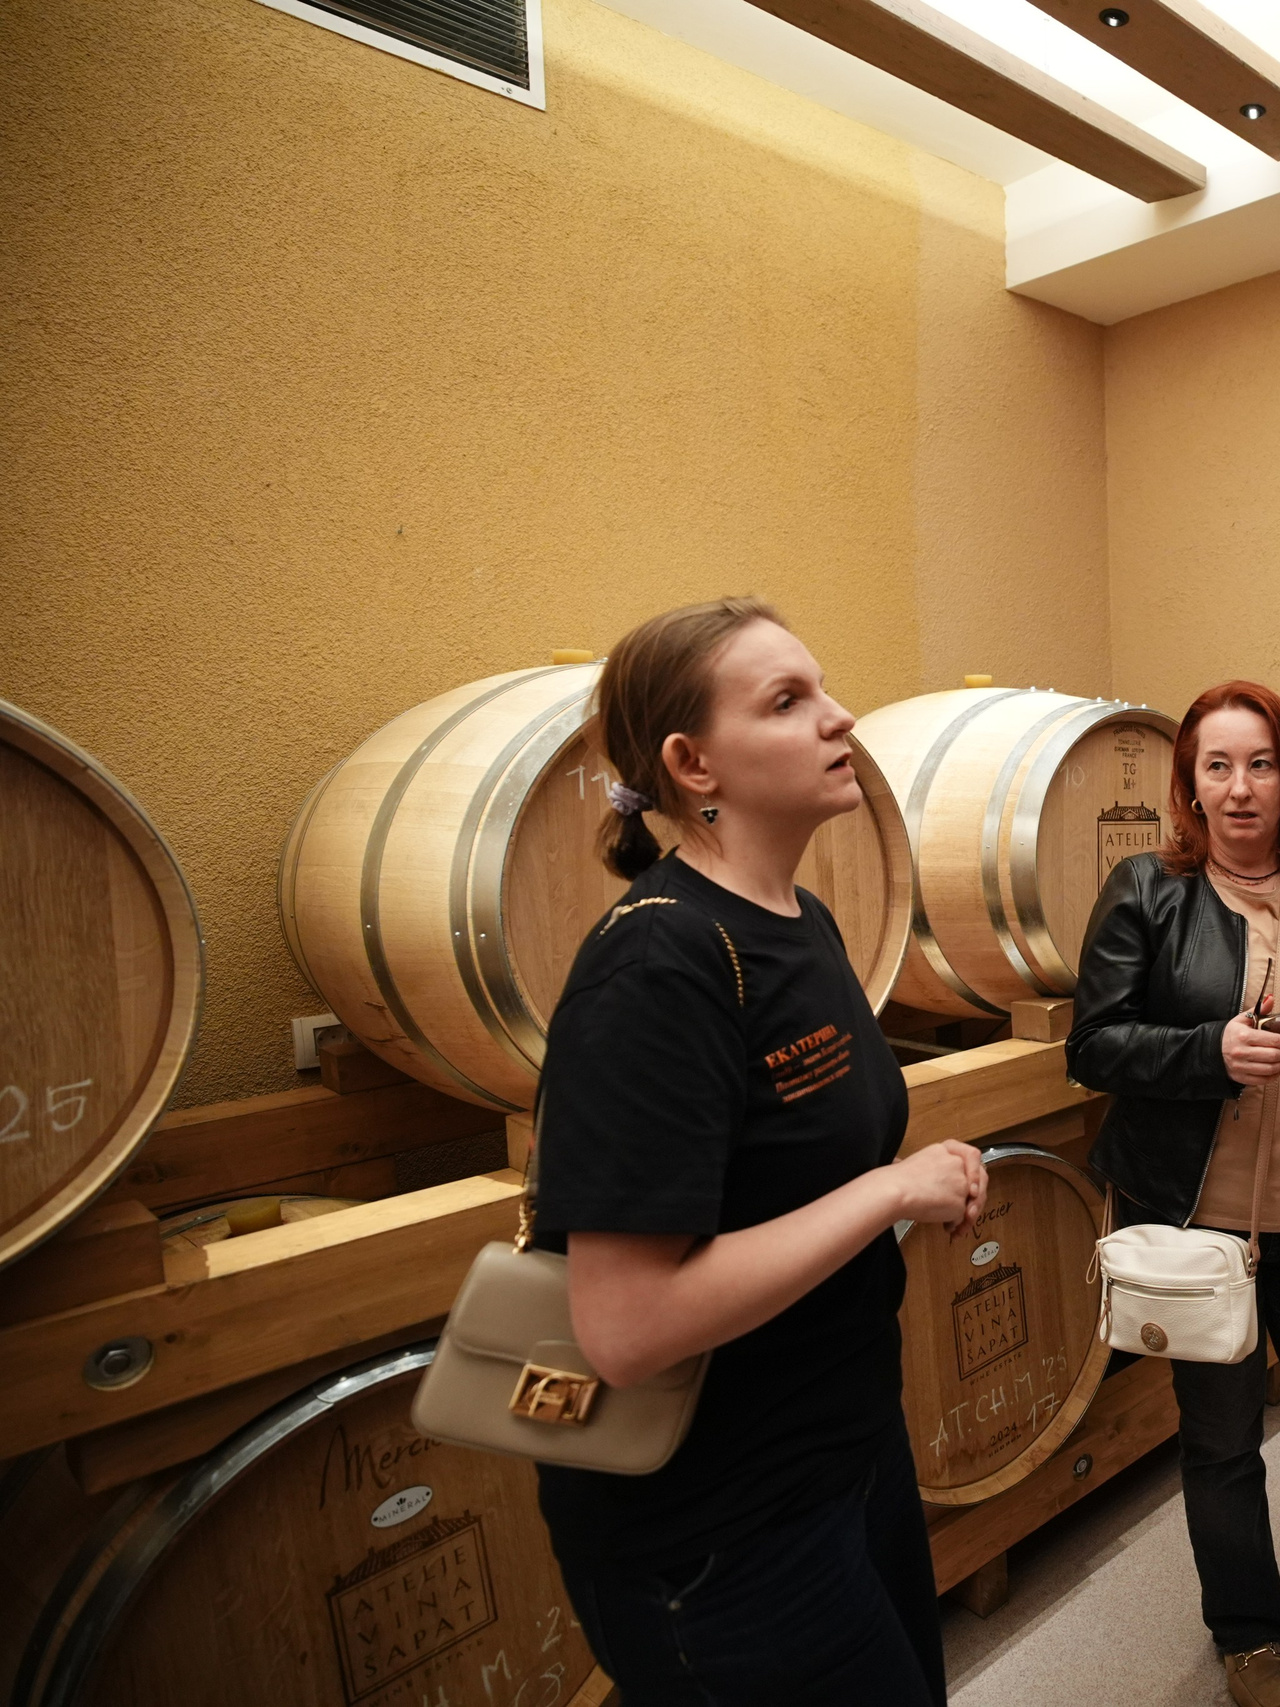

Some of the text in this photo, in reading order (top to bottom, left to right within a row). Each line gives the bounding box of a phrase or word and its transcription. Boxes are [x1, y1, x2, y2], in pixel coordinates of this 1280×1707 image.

[1060, 760, 1086, 790] 10
[1122, 763, 1137, 775] TG
[1123, 778, 1136, 790] M+
[1105, 832, 1153, 848] ATELJE
[974, 1248, 998, 1262] MINERAL
[963, 1286, 1015, 1325] ATELJE
[964, 1307, 1017, 1343] VINA
[966, 1325, 1018, 1365] ŠAPAT
[969, 1351, 1022, 1386] WINE ESTATE
[1026, 1392, 1061, 1433] 17
[989, 1421, 1018, 1448] 2024
[377, 1495, 427, 1523] MINERAL
[353, 1545, 468, 1620] ATELJE
[357, 1576, 472, 1646] VINA
[363, 1601, 475, 1679] ŠAPAT
